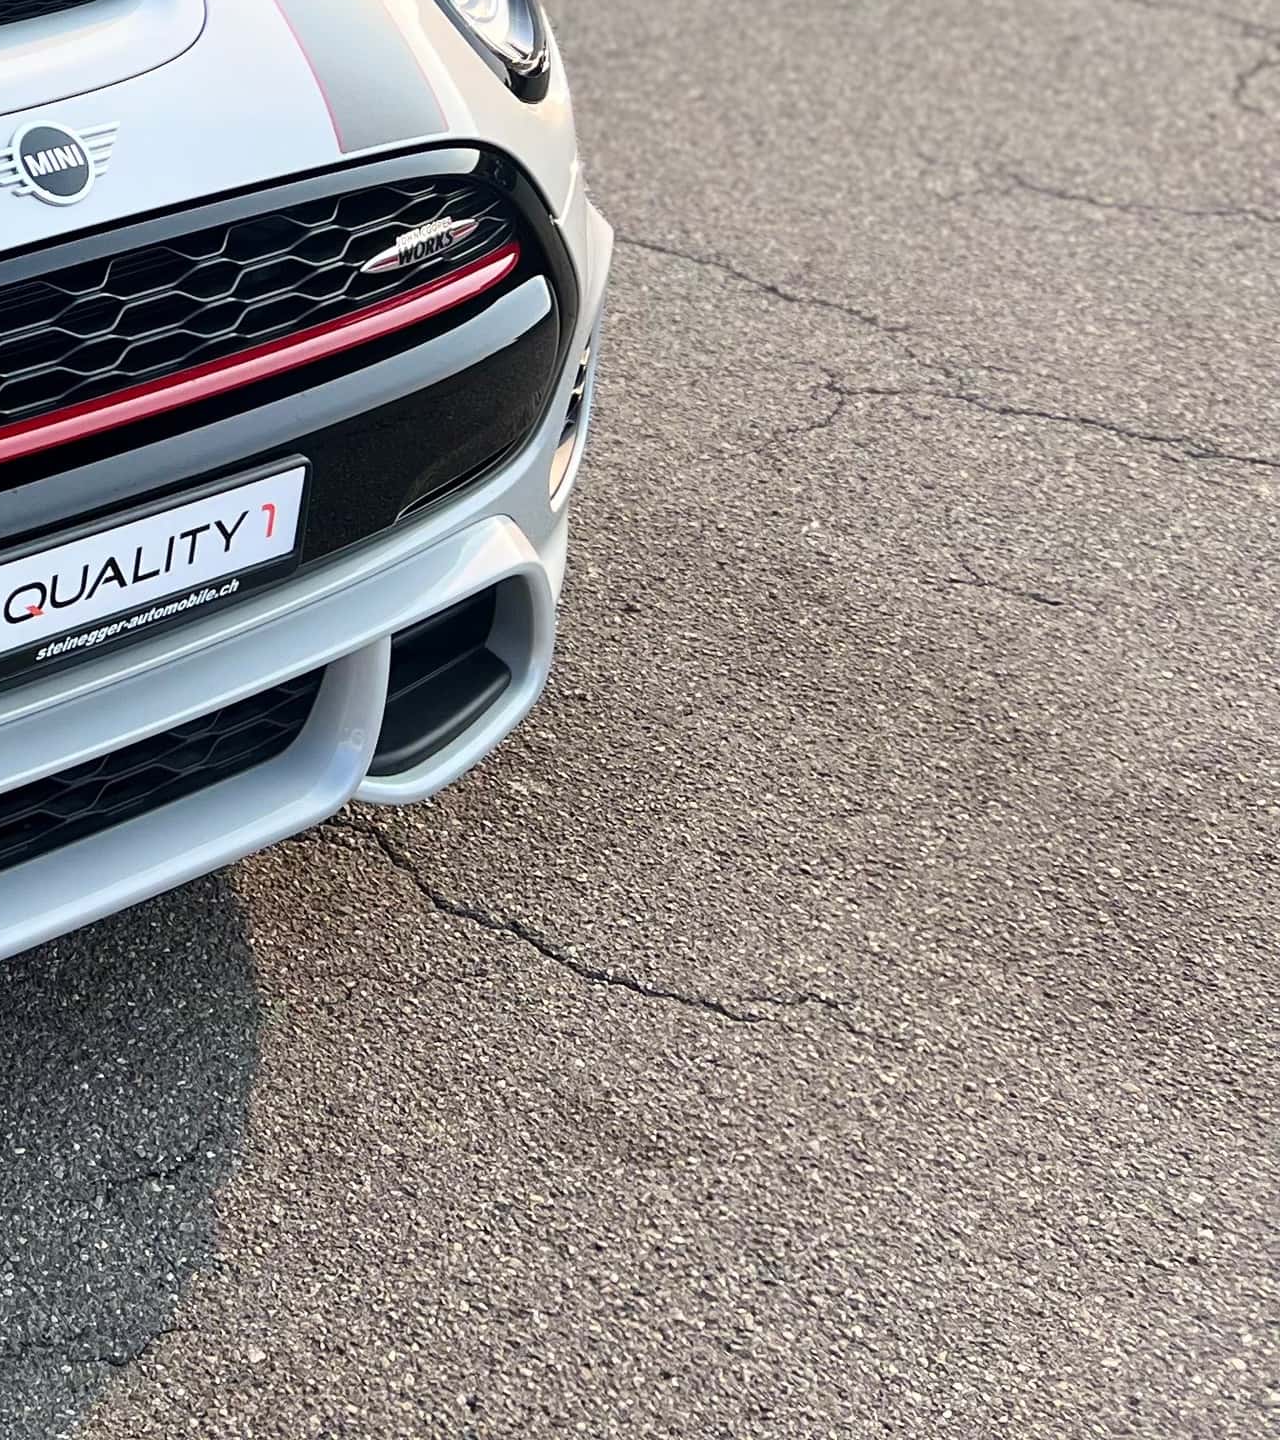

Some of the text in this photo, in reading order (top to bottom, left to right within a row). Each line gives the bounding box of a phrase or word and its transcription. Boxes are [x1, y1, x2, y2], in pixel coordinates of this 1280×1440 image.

[23, 143, 85, 177] MINI
[398, 229, 454, 266] WORKS
[4, 503, 276, 624] QUALITY 1
[35, 578, 239, 661] steinegger-automobile.ch
